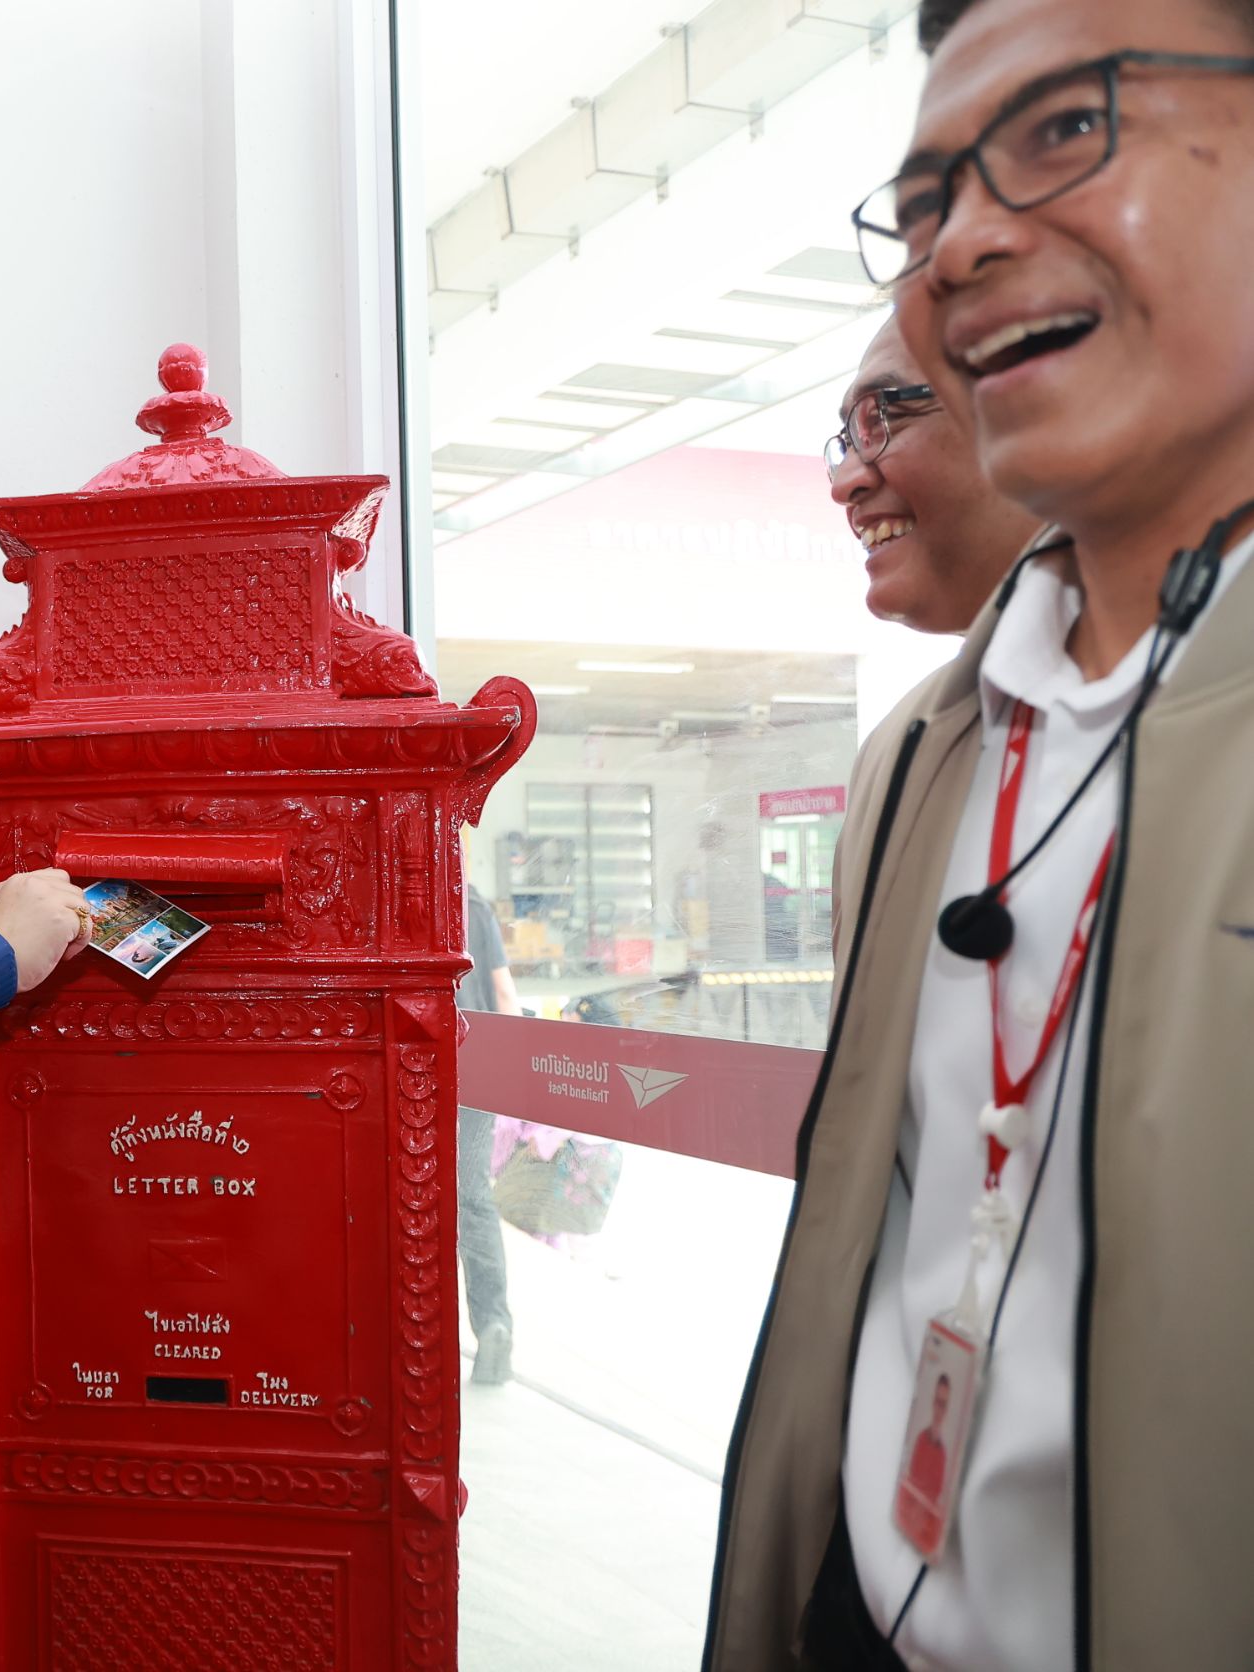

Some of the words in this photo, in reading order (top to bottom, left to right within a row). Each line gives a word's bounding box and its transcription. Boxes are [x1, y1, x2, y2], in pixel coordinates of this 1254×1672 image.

[113, 1176, 199, 1196] LETTER
[214, 1178, 257, 1197] BOX
[154, 1343, 222, 1360] CLEARED
[86, 1386, 114, 1399] FOR
[240, 1390, 320, 1407] DELIVERY
